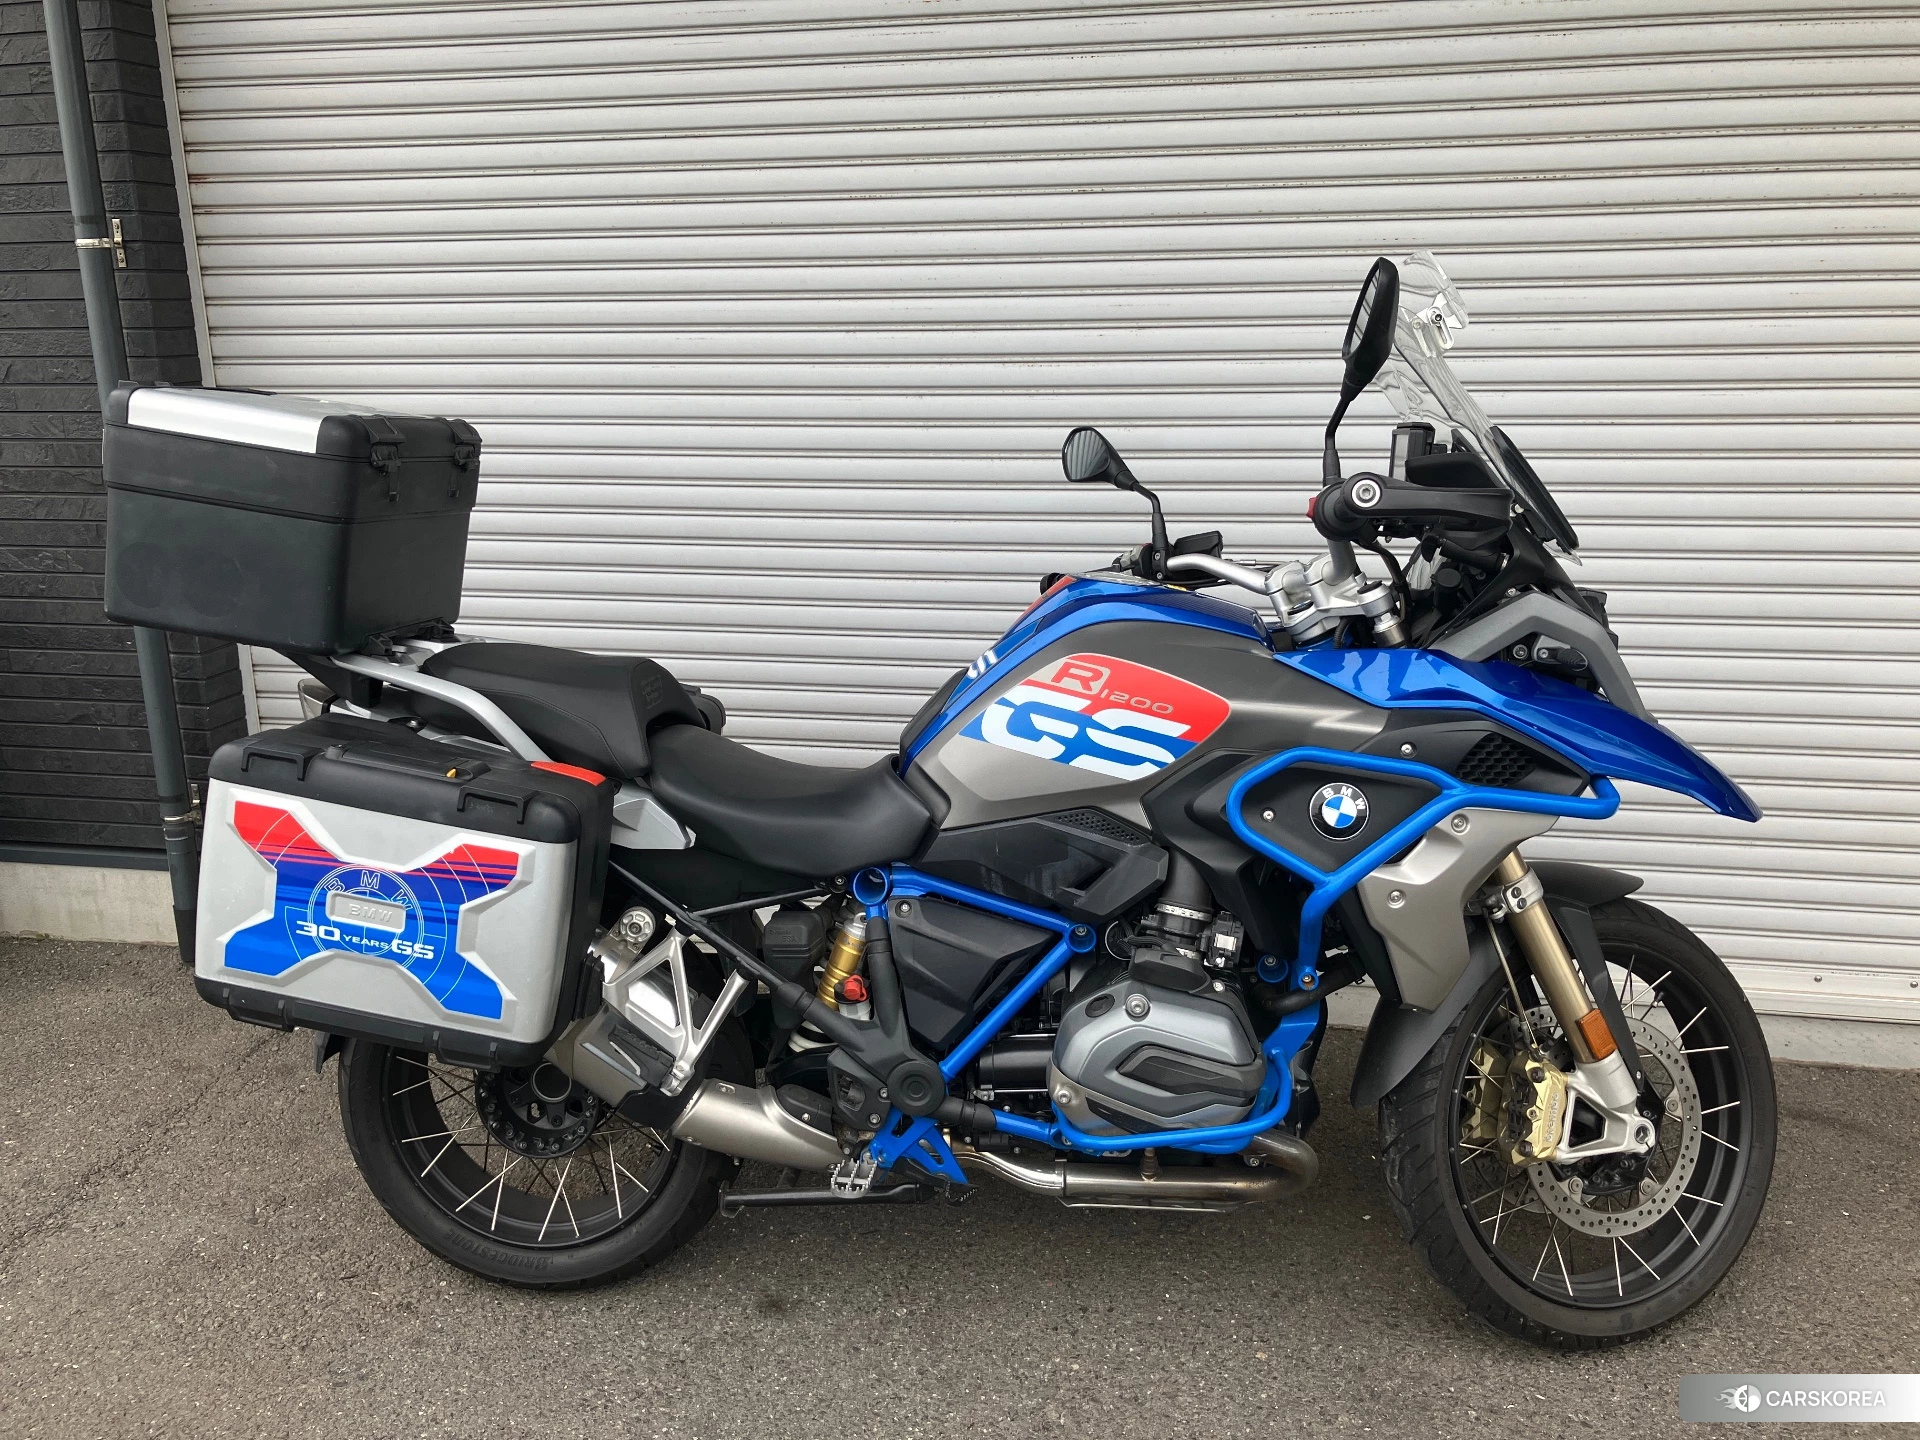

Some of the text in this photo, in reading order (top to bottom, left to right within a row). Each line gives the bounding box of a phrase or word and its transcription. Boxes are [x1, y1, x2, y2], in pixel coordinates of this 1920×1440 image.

[1050, 660, 1174, 715] R 1200
[981, 684, 1192, 782] GS
[1322, 785, 1366, 810] BMW
[324, 870, 413, 911] BMW
[349, 903, 393, 923] BMW
[296, 920, 435, 960] 30 YEARS GS
[1545, 1092, 1559, 1142] brembo
